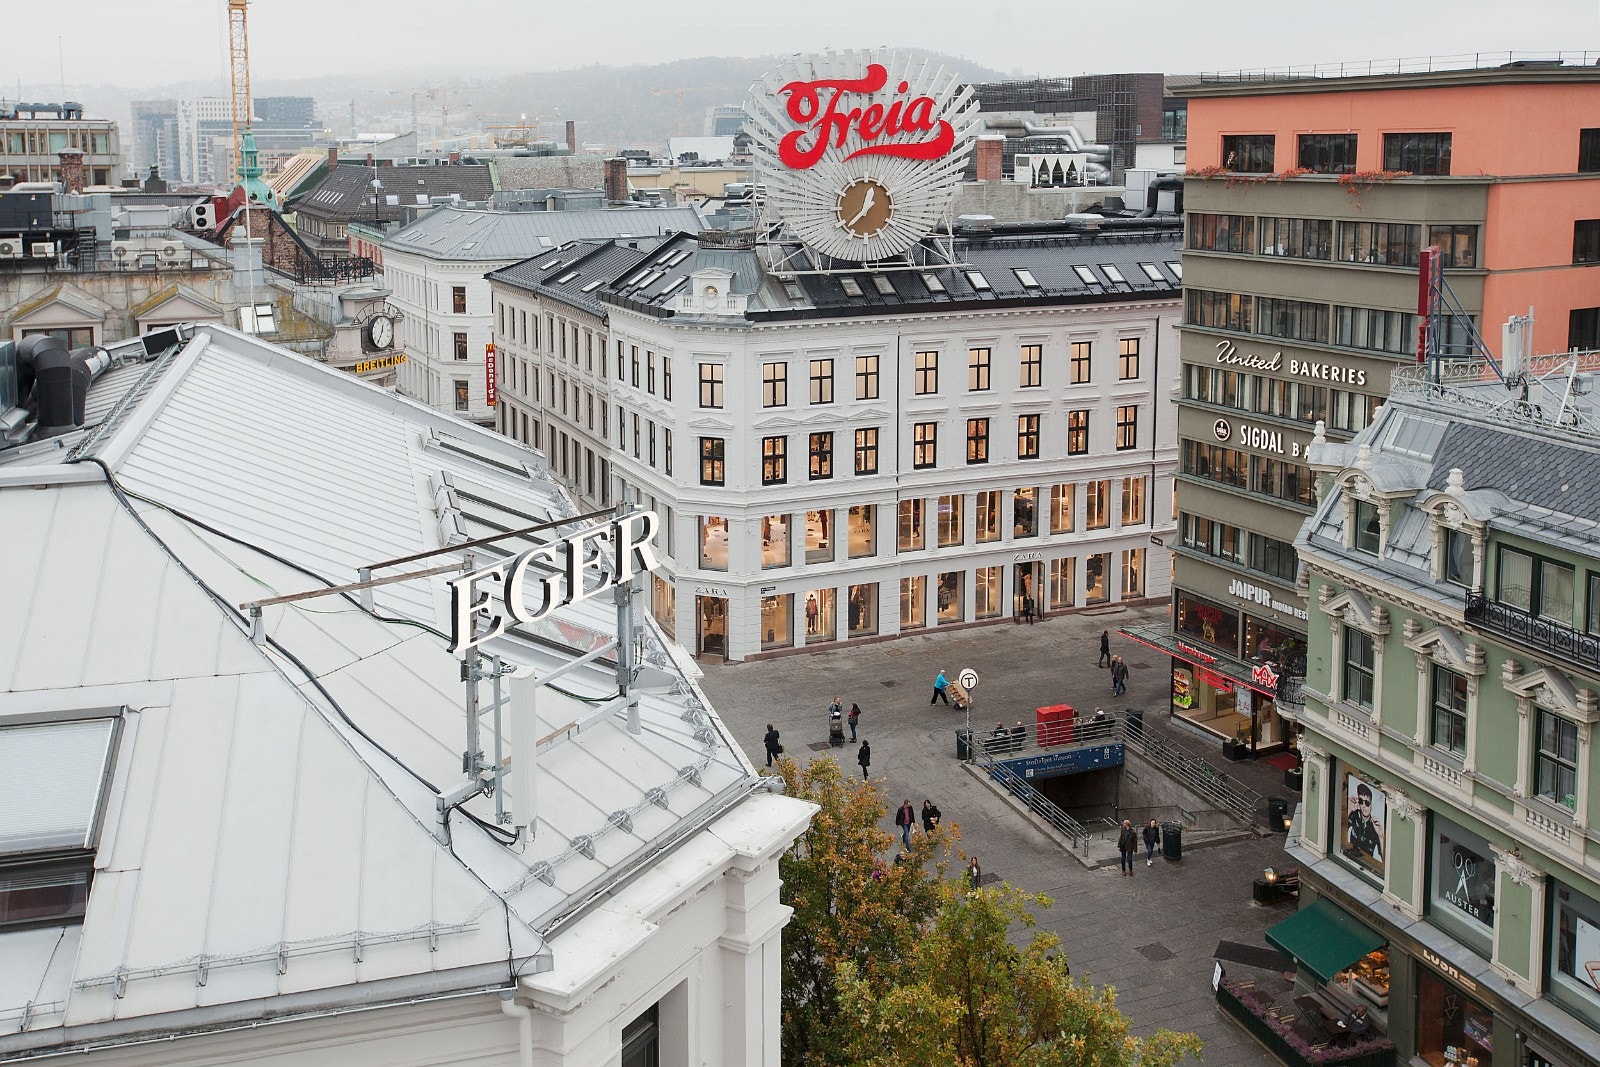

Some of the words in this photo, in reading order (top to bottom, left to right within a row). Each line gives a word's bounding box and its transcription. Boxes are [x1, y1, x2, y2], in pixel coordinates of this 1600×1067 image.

[777, 63, 955, 169] Freia
[355, 353, 407, 373] BREITLING
[487, 352, 495, 398] McDonald's
[1215, 340, 1282, 371] United
[1290, 359, 1366, 386] BAKERIES
[1240, 424, 1285, 454] SIGDAL
[1012, 552, 1043, 561] ZARA
[446, 510, 661, 653] EGER
[694, 586, 728, 596] ZARA
[1228, 578, 1271, 607] JAIPUR
[1252, 664, 1279, 689] MAX
[1445, 891, 1479, 917] AUSTER
